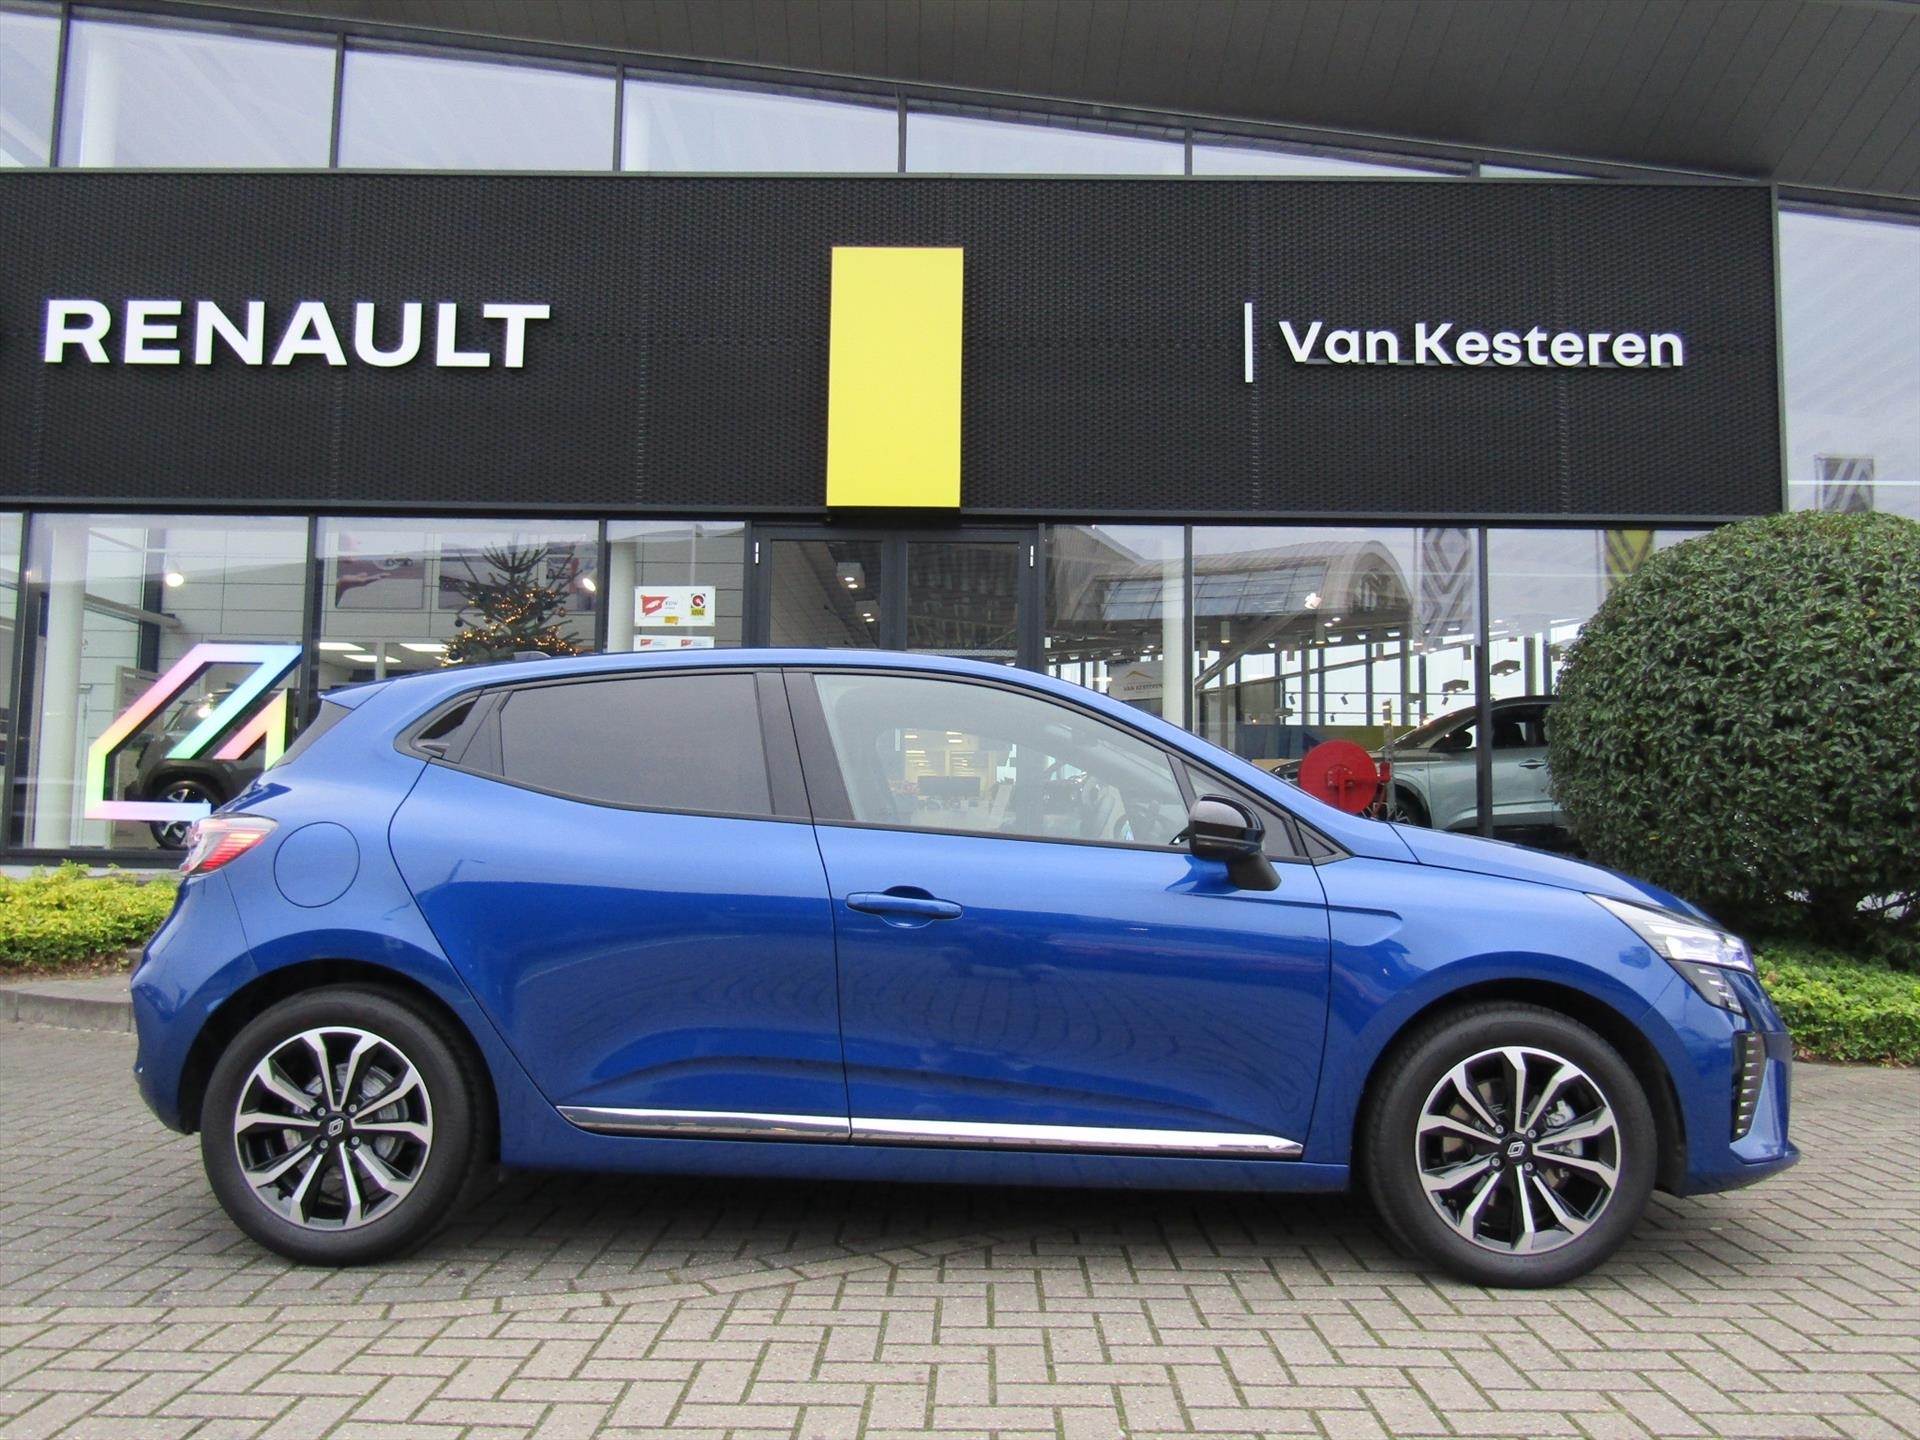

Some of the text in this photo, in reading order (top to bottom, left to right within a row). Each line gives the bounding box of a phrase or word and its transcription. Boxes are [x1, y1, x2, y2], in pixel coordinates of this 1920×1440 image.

[43, 299, 551, 368] RENAULT
[1278, 320, 1685, 367] Van Kesteren
